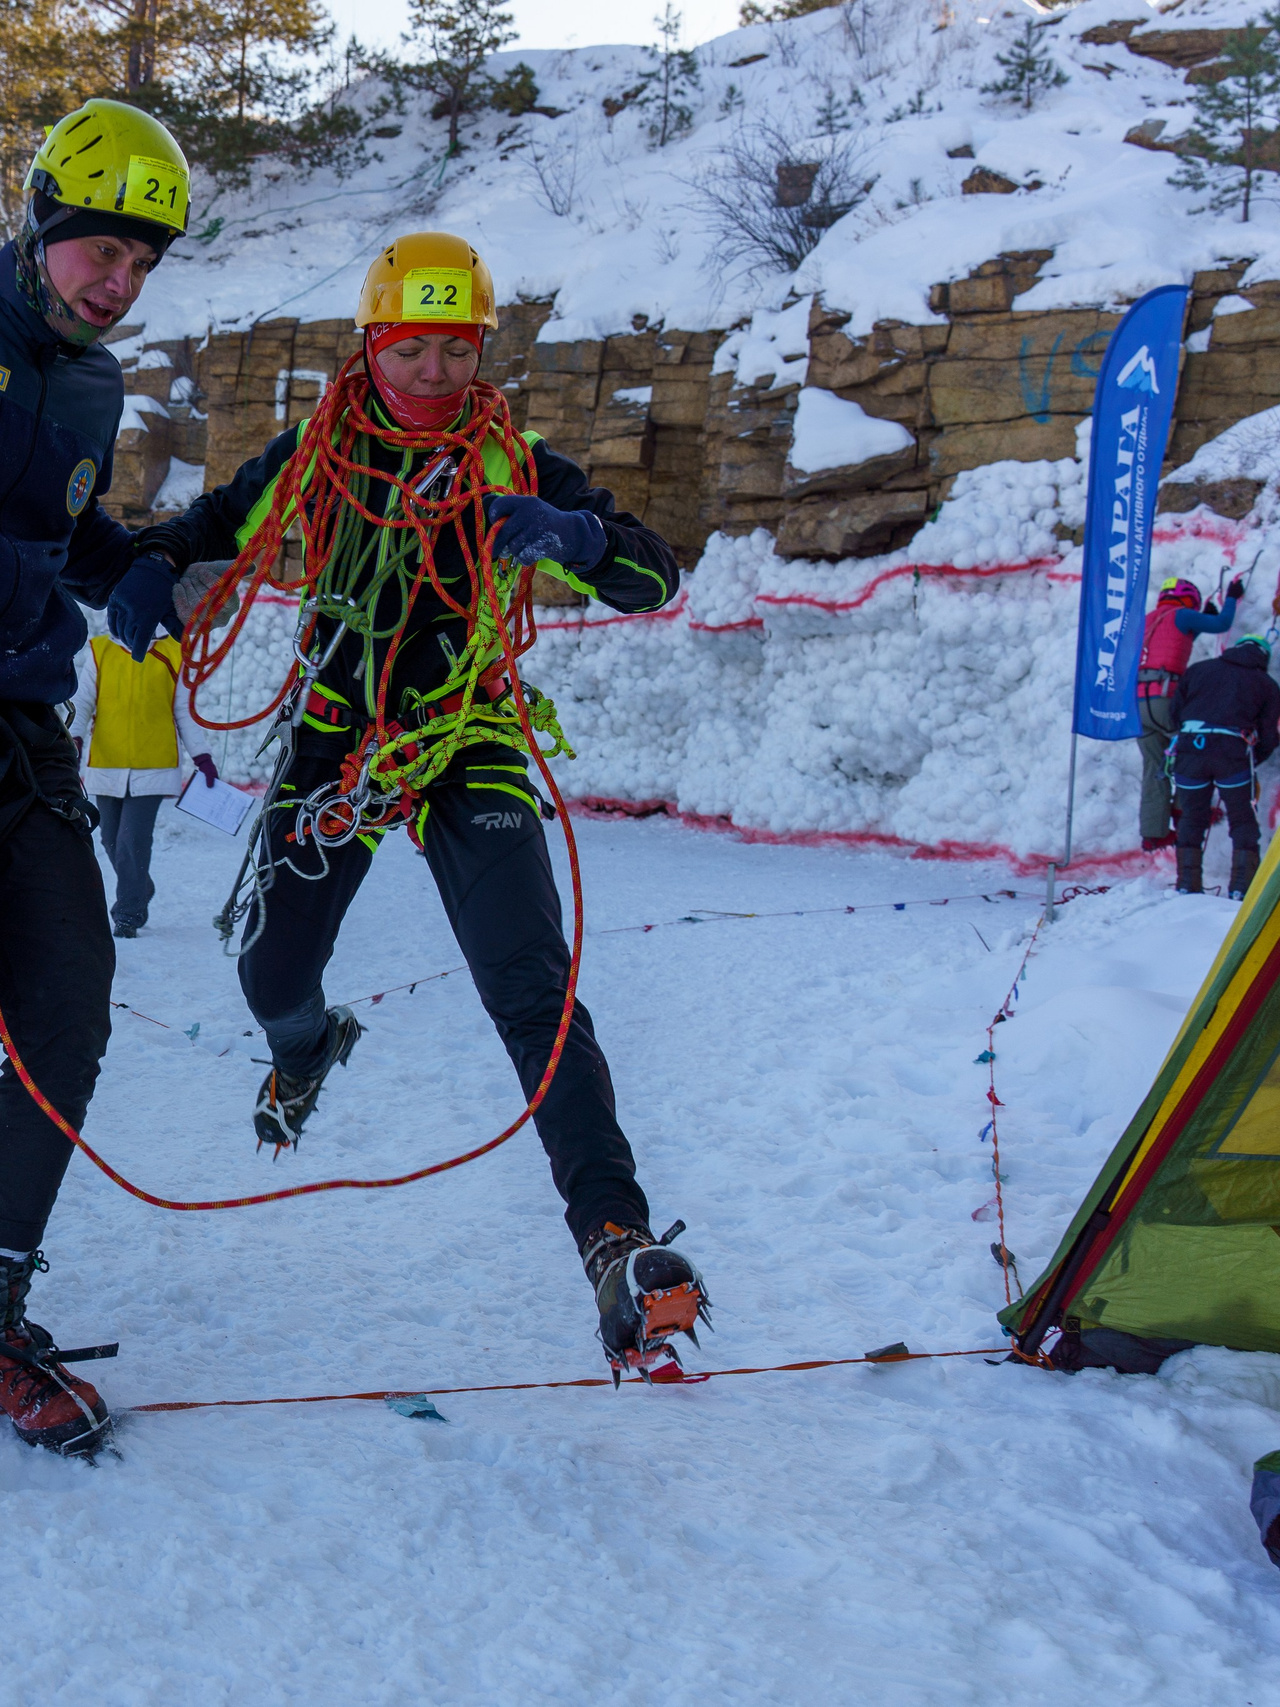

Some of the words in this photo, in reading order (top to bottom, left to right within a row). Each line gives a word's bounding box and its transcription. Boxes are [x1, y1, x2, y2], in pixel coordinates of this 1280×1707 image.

[143, 177, 178, 210] 2.1
[420, 284, 457, 306] 2.2
[371, 321, 390, 343] ACE
[1134, 464, 1145, 543] АКТИВНОГО
[1094, 404, 1140, 691] МАНАРАГА
